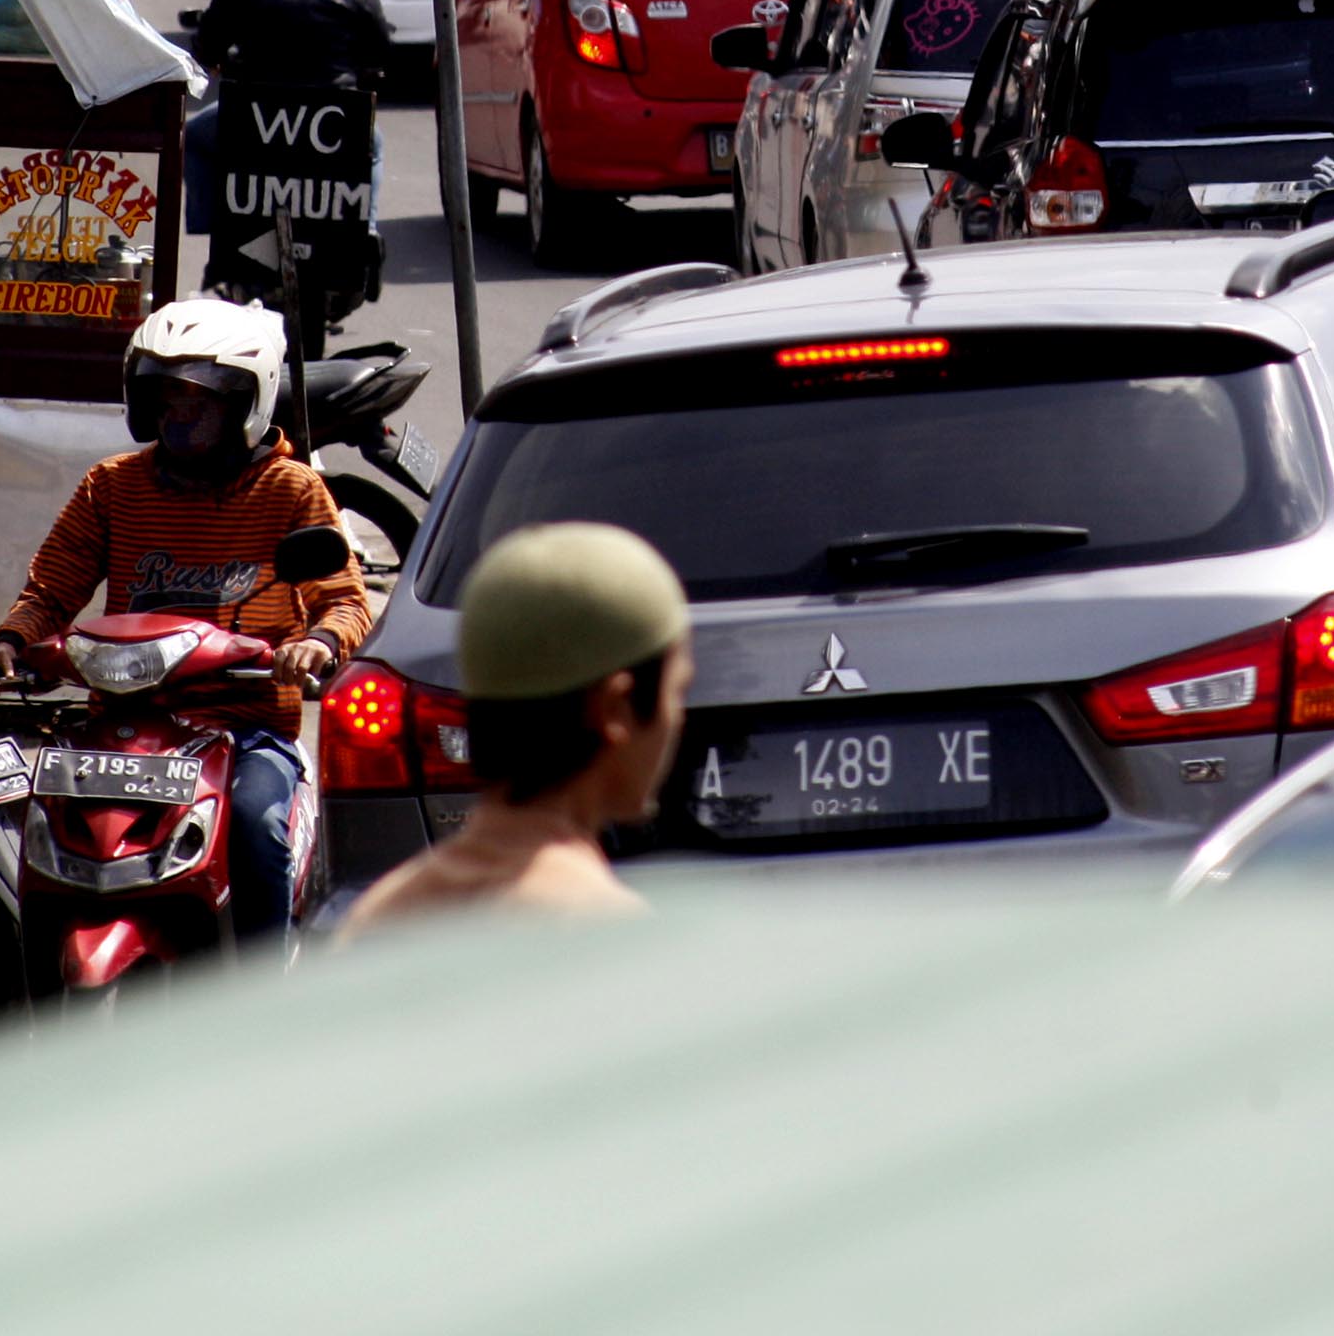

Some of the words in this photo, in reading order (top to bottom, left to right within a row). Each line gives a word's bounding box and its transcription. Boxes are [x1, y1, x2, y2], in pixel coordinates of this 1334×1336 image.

[250, 100, 346, 155] WC
[225, 172, 372, 222] UMUM
[43, 751, 62, 771] F
[76, 755, 141, 777] 2195
[165, 760, 198, 782] NG
[700, 746, 723, 799] A
[793, 734, 893, 792] 1489
[937, 729, 990, 783] XE
